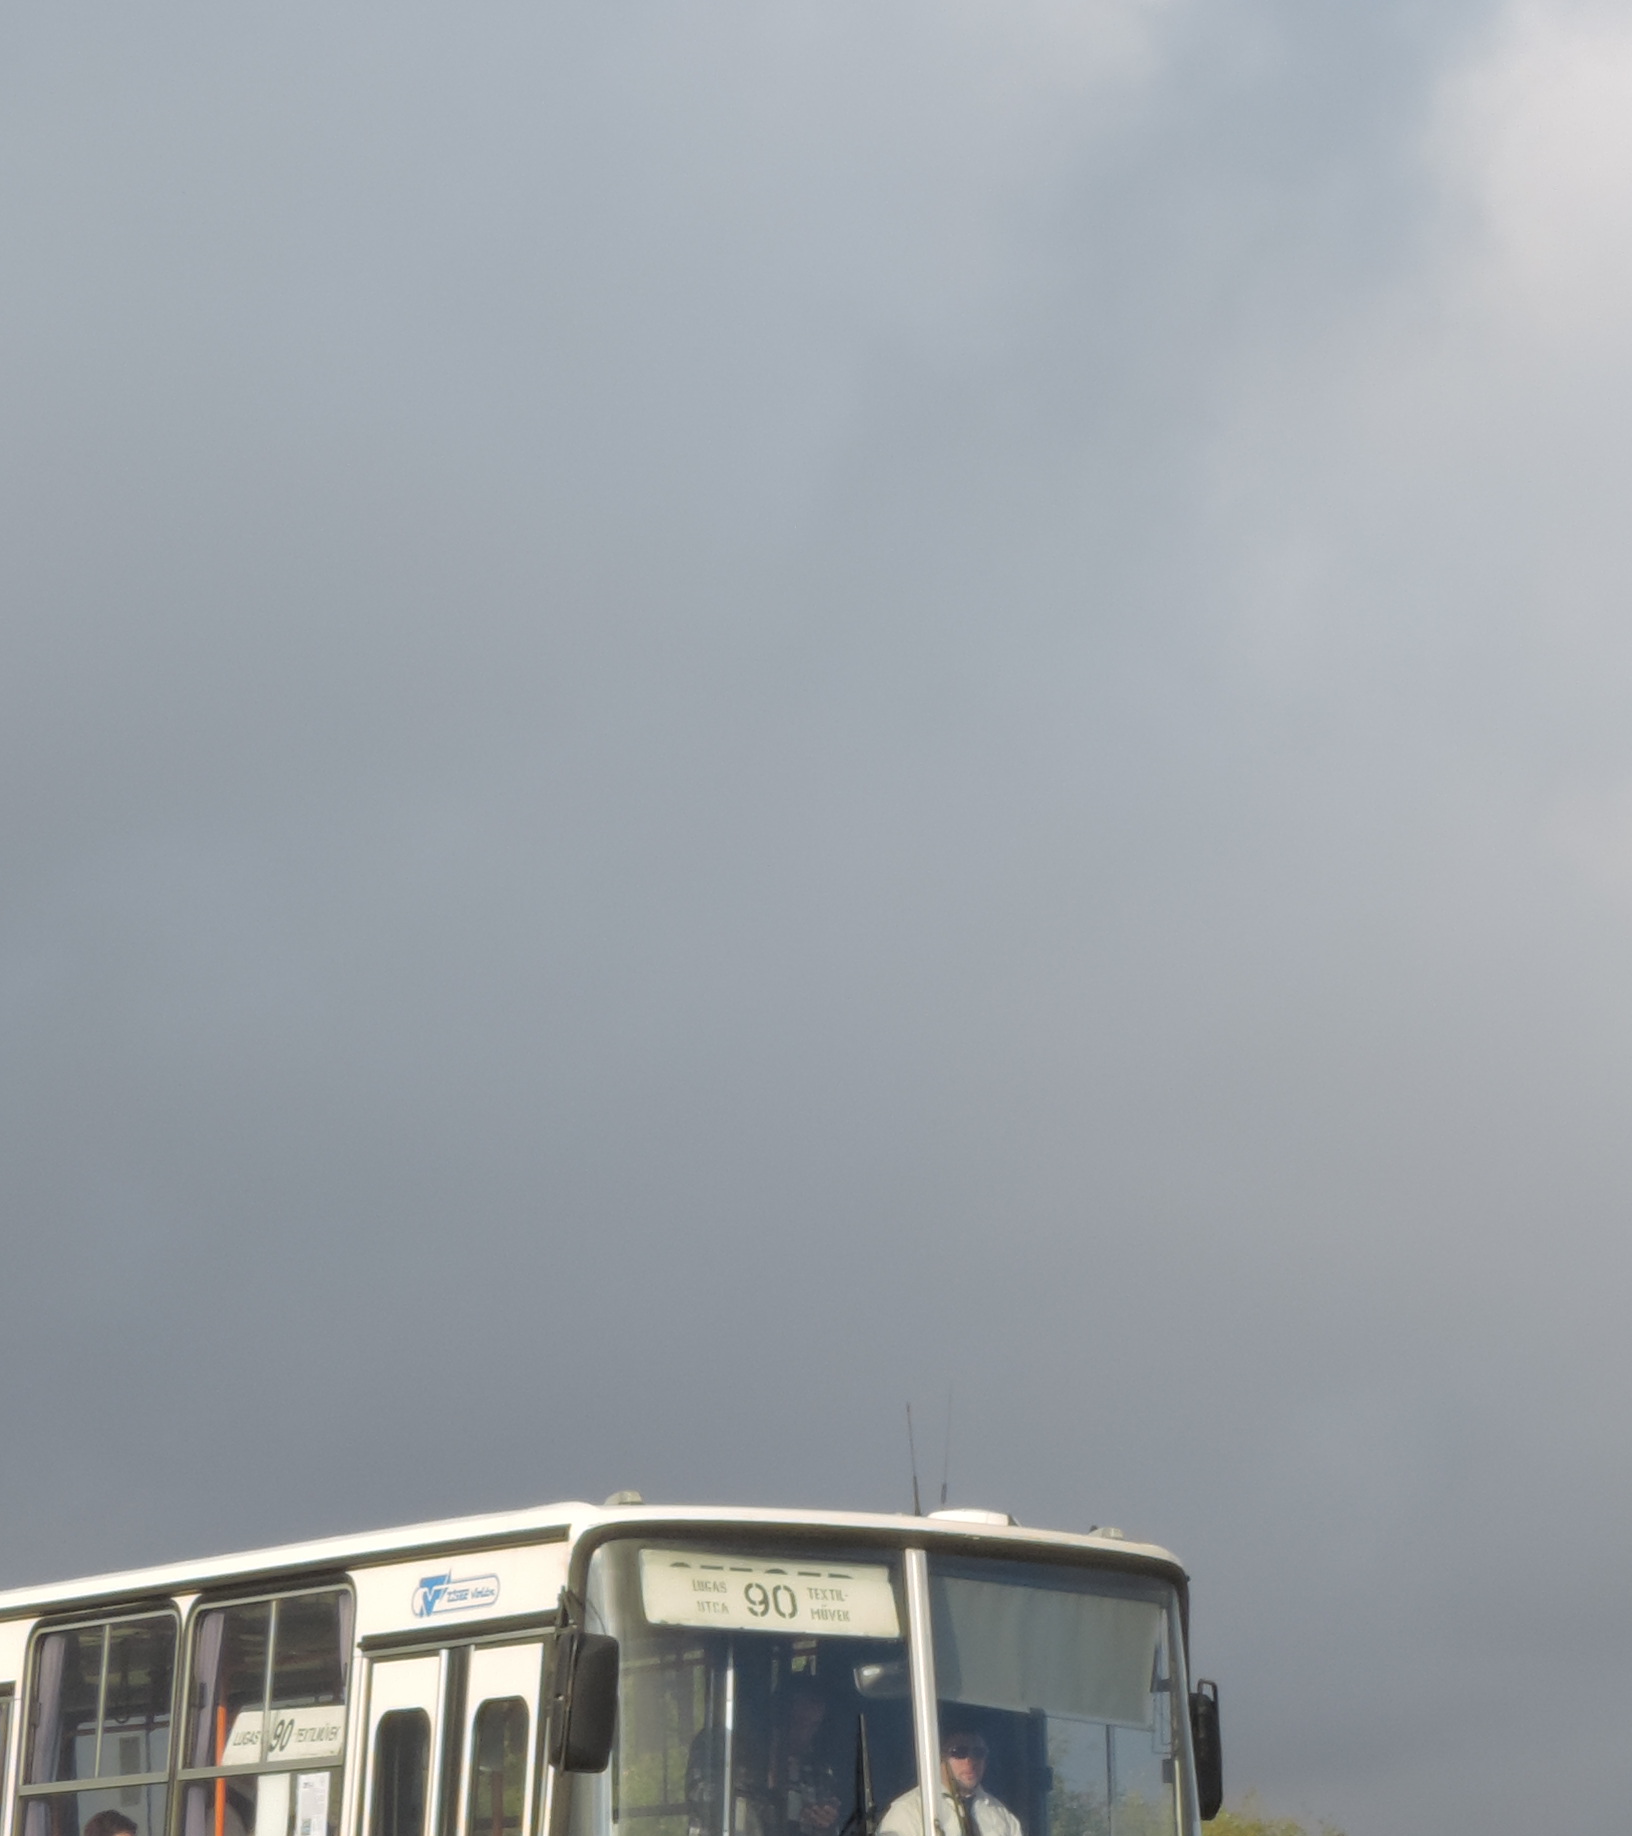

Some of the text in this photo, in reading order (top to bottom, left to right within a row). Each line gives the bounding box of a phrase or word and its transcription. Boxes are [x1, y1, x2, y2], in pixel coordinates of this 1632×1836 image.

[692, 1578, 728, 1594] LUGAS
[806, 1586, 849, 1602] TEXTIL-
[696, 1600, 730, 1615] UTCA
[743, 1582, 799, 1620] 90
[268, 1718, 295, 1753] 90
